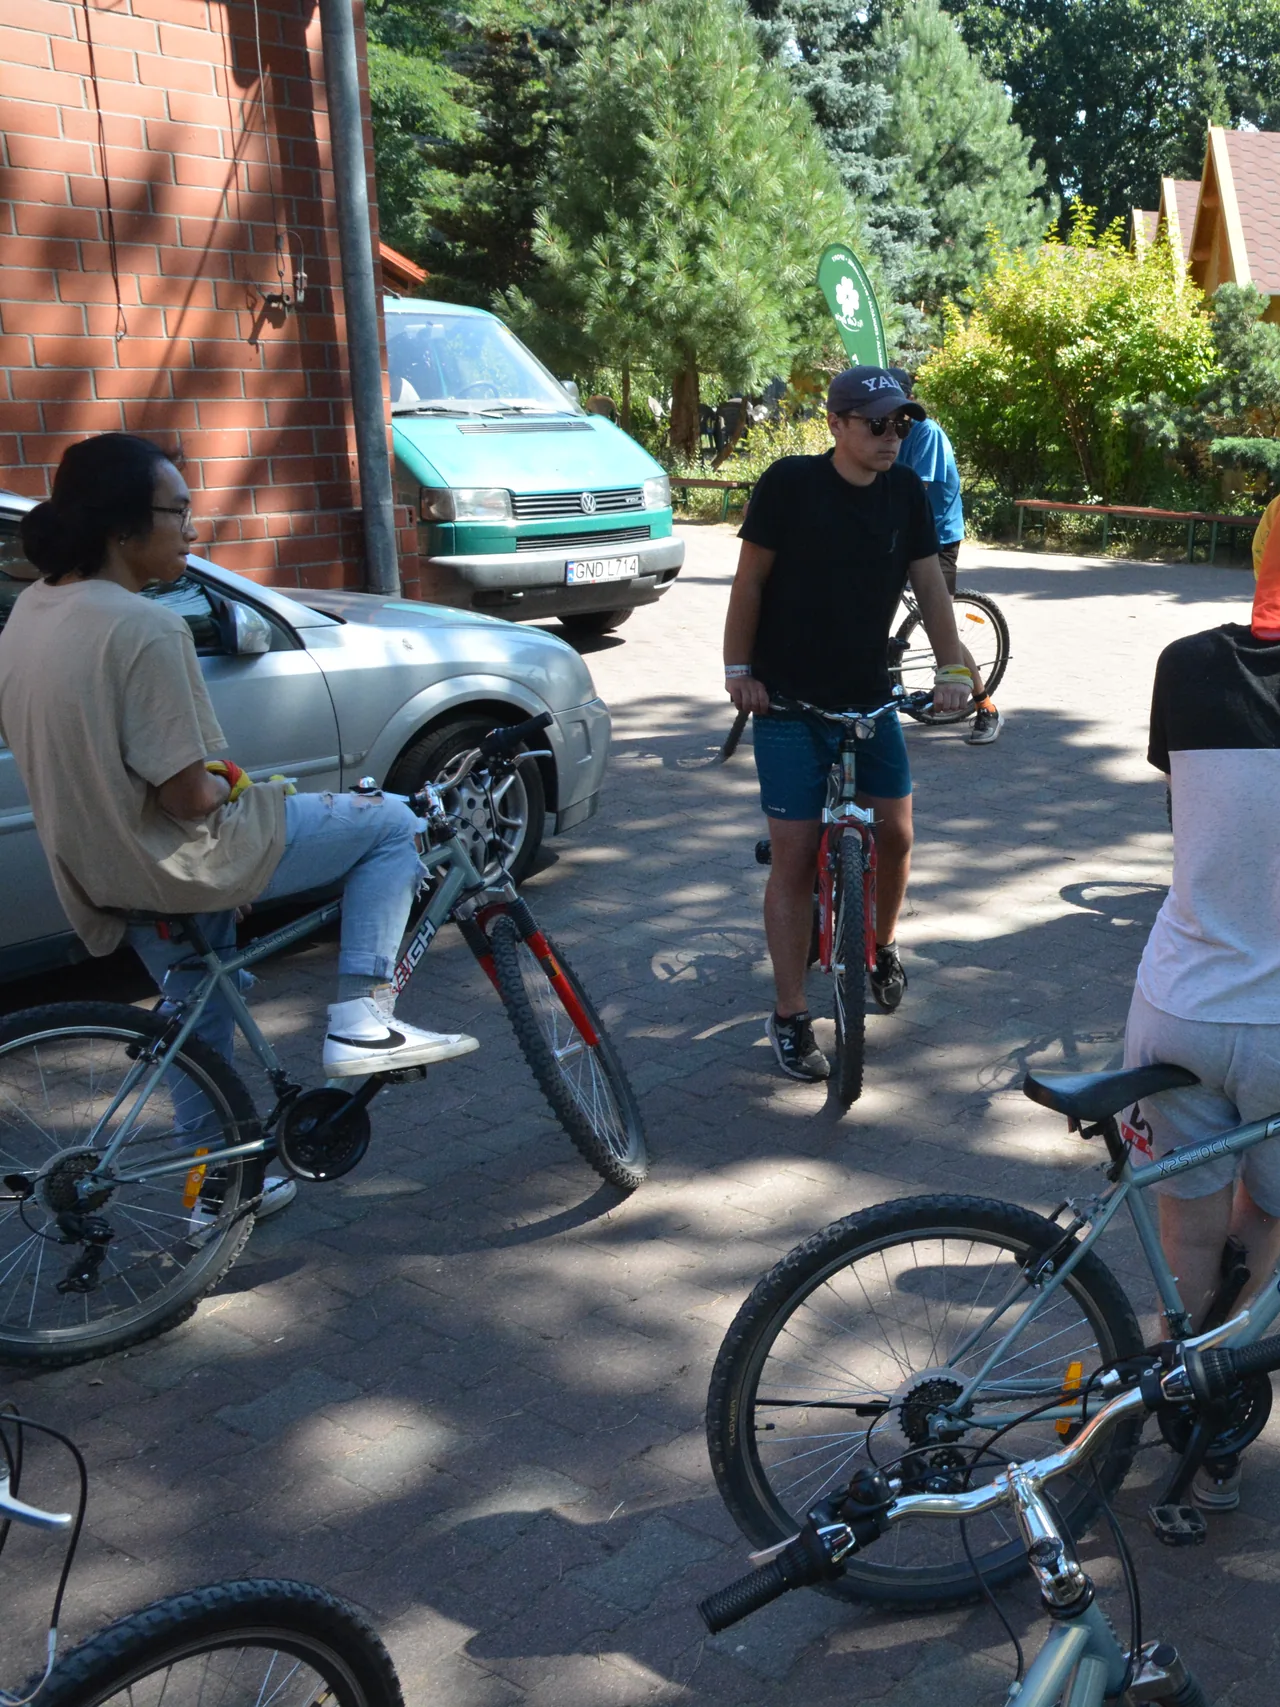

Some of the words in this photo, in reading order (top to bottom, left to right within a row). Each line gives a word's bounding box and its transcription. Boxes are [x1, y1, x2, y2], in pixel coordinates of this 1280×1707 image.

[861, 376, 901, 392] YAL
[576, 562, 603, 578] GND
[607, 559, 636, 576] L714
[392, 917, 437, 993] EIGH
[1155, 1136, 1232, 1176] X2SHOCK
